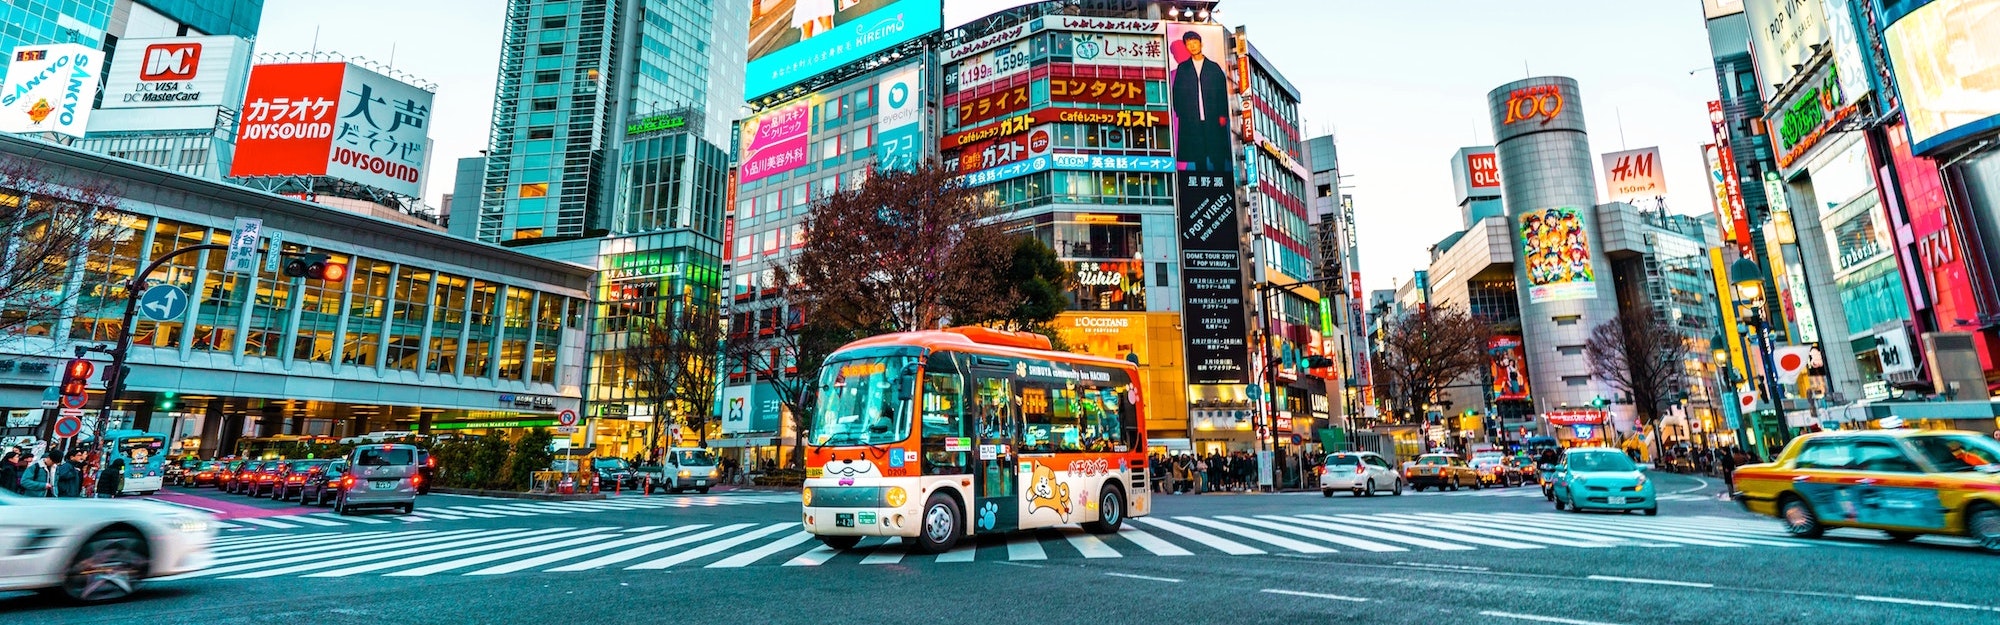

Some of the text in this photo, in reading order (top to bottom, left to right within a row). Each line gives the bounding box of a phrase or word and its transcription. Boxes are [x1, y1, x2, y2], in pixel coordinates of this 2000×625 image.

[1784, 0, 1803, 20] VIR
[856, 13, 904, 47] KIREIMO
[1063, 18, 1159, 31] しゃぶしゃぶバイキング
[951, 26, 1022, 58] しゃぶしゃぶバイキング
[1104, 39, 1161, 57] しゃぶ葉
[144, 48, 194, 76] DC
[995, 51, 1029, 76] 1,599円
[2, 55, 69, 107] SANKYO
[950, 72, 963, 86] 9F
[961, 64, 992, 86] 1,199円
[59, 53, 92, 126] SANKYO
[136, 82, 193, 92] DC VISA &
[1051, 80, 1142, 99] コンタクト
[1510, 84, 1559, 99] SHIBUYA
[123, 91, 200, 103] DC MasterCard
[960, 87, 1028, 121] プライス
[246, 97, 334, 121] カラオケ
[342, 83, 428, 133] 大声
[883, 109, 912, 124] eyecity
[1503, 92, 1563, 126] 109
[771, 109, 806, 128] 品川スキン
[1000, 114, 1035, 137] ガスト
[1116, 109, 1159, 127] ガスト
[242, 122, 331, 140] JOYSOUND
[771, 121, 801, 139] クリニック
[336, 122, 422, 165] だそうぜ。
[750, 147, 803, 175] 品川美容外科
[982, 141, 1024, 168] ガスト
[1034, 159, 1045, 168] 6F
[1091, 158, 1172, 169] 英会話イーオン
[1472, 157, 1497, 170] UN
[332, 146, 419, 184] JOYSOUND
[944, 158, 959, 172] 7F
[969, 163, 1030, 186] 英会話イーオン
[1612, 153, 1652, 182] H&M
[1200, 206, 1233, 242] NOW ON SALE!
[238, 223, 256, 268] 渋谷駅前
[606, 264, 681, 279] MARK CITY
[624, 259, 660, 268] SHIBUYA
[1078, 271, 1121, 286] Ushi8
[1075, 317, 1128, 327] L'OCCITANE
[1029, 365, 1052, 377] SHIBUYA
[1052, 369, 1079, 381] community
[1089, 371, 1110, 382] HACHIKO
[1068, 459, 1109, 476] ハチ公バス
